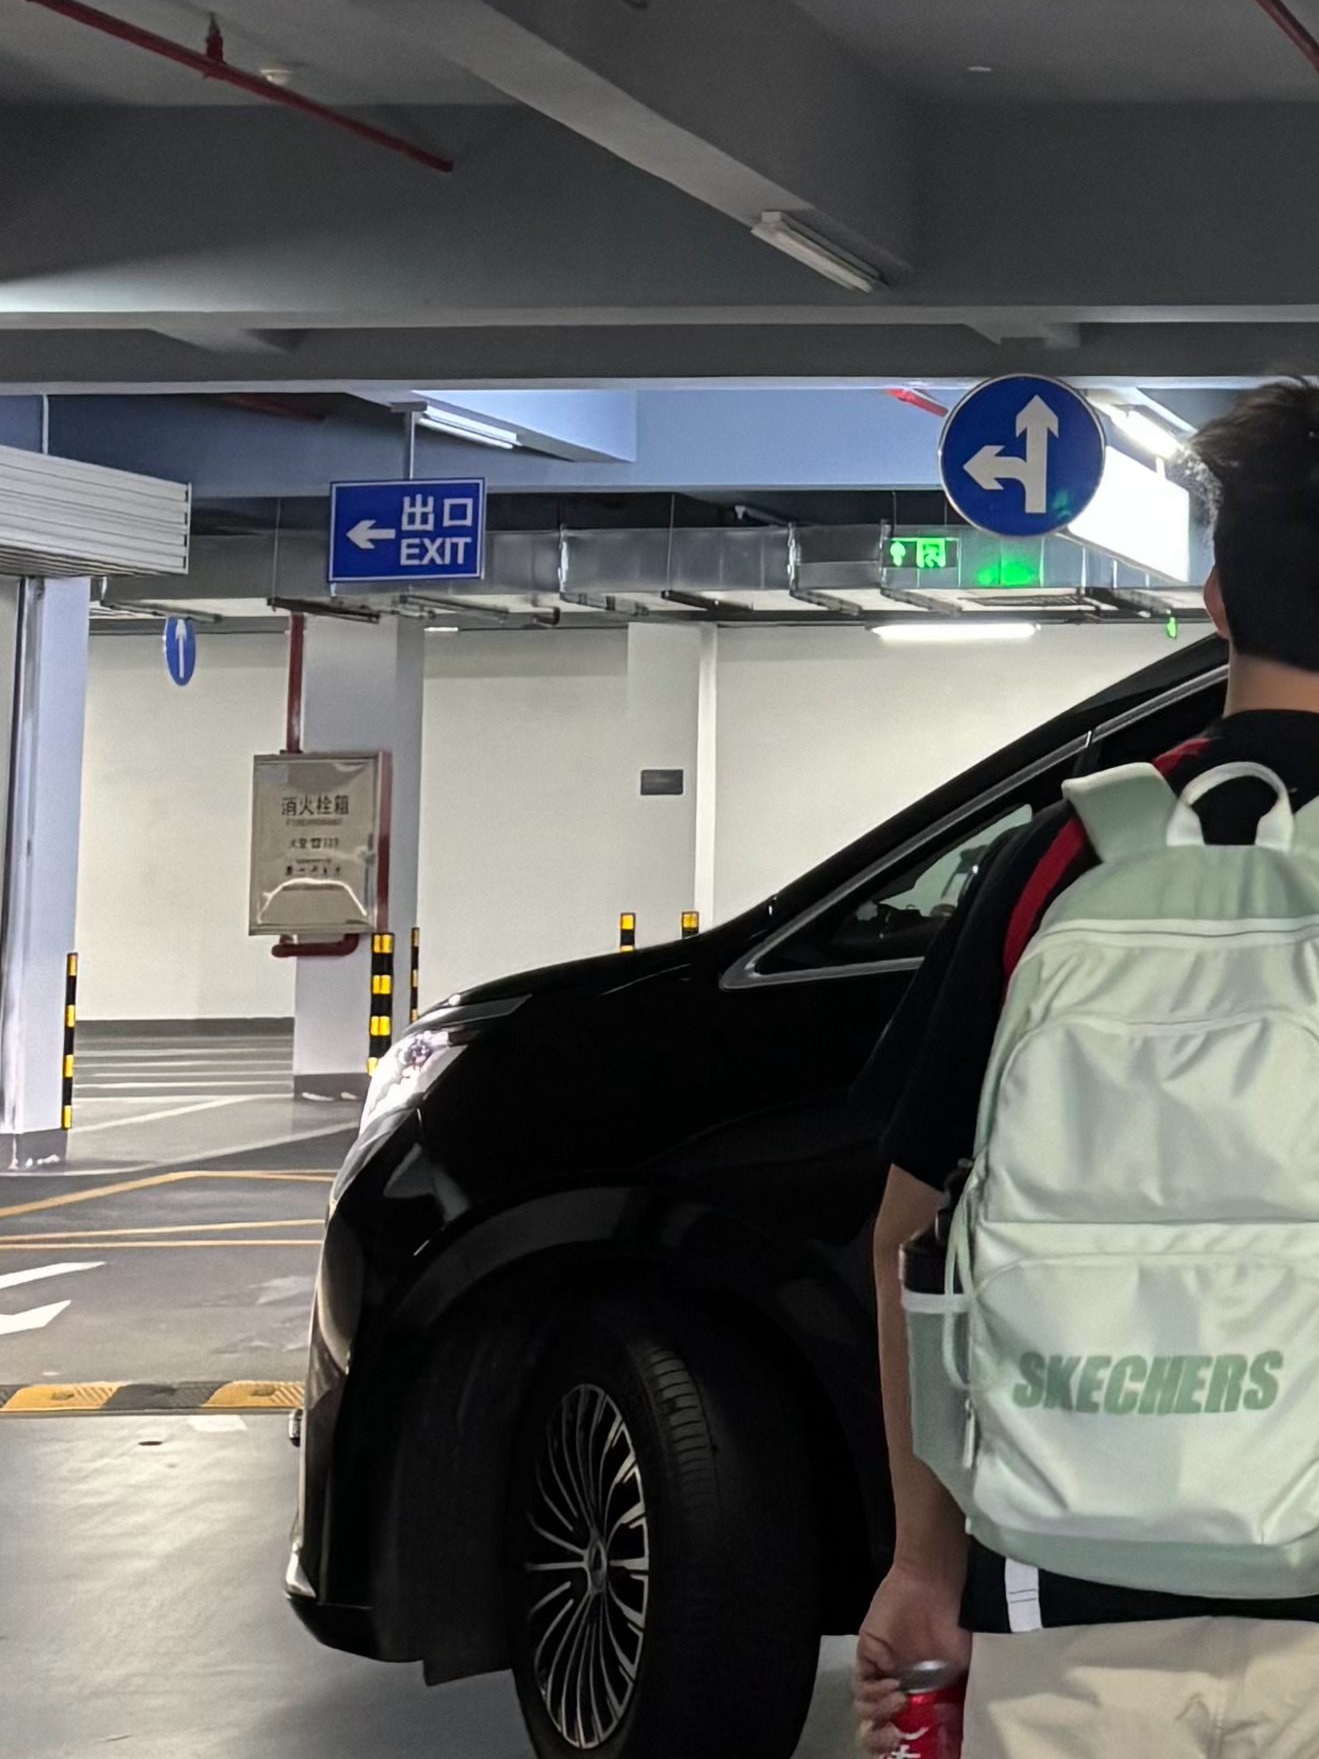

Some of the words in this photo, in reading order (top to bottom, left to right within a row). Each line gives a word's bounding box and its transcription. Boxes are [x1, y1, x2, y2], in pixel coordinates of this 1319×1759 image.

[401, 493, 474, 531] 出口
[400, 536, 472, 566] EXIT
[281, 794, 350, 816] 消火栓箱
[1012, 1350, 1284, 1415] SKECHERS
